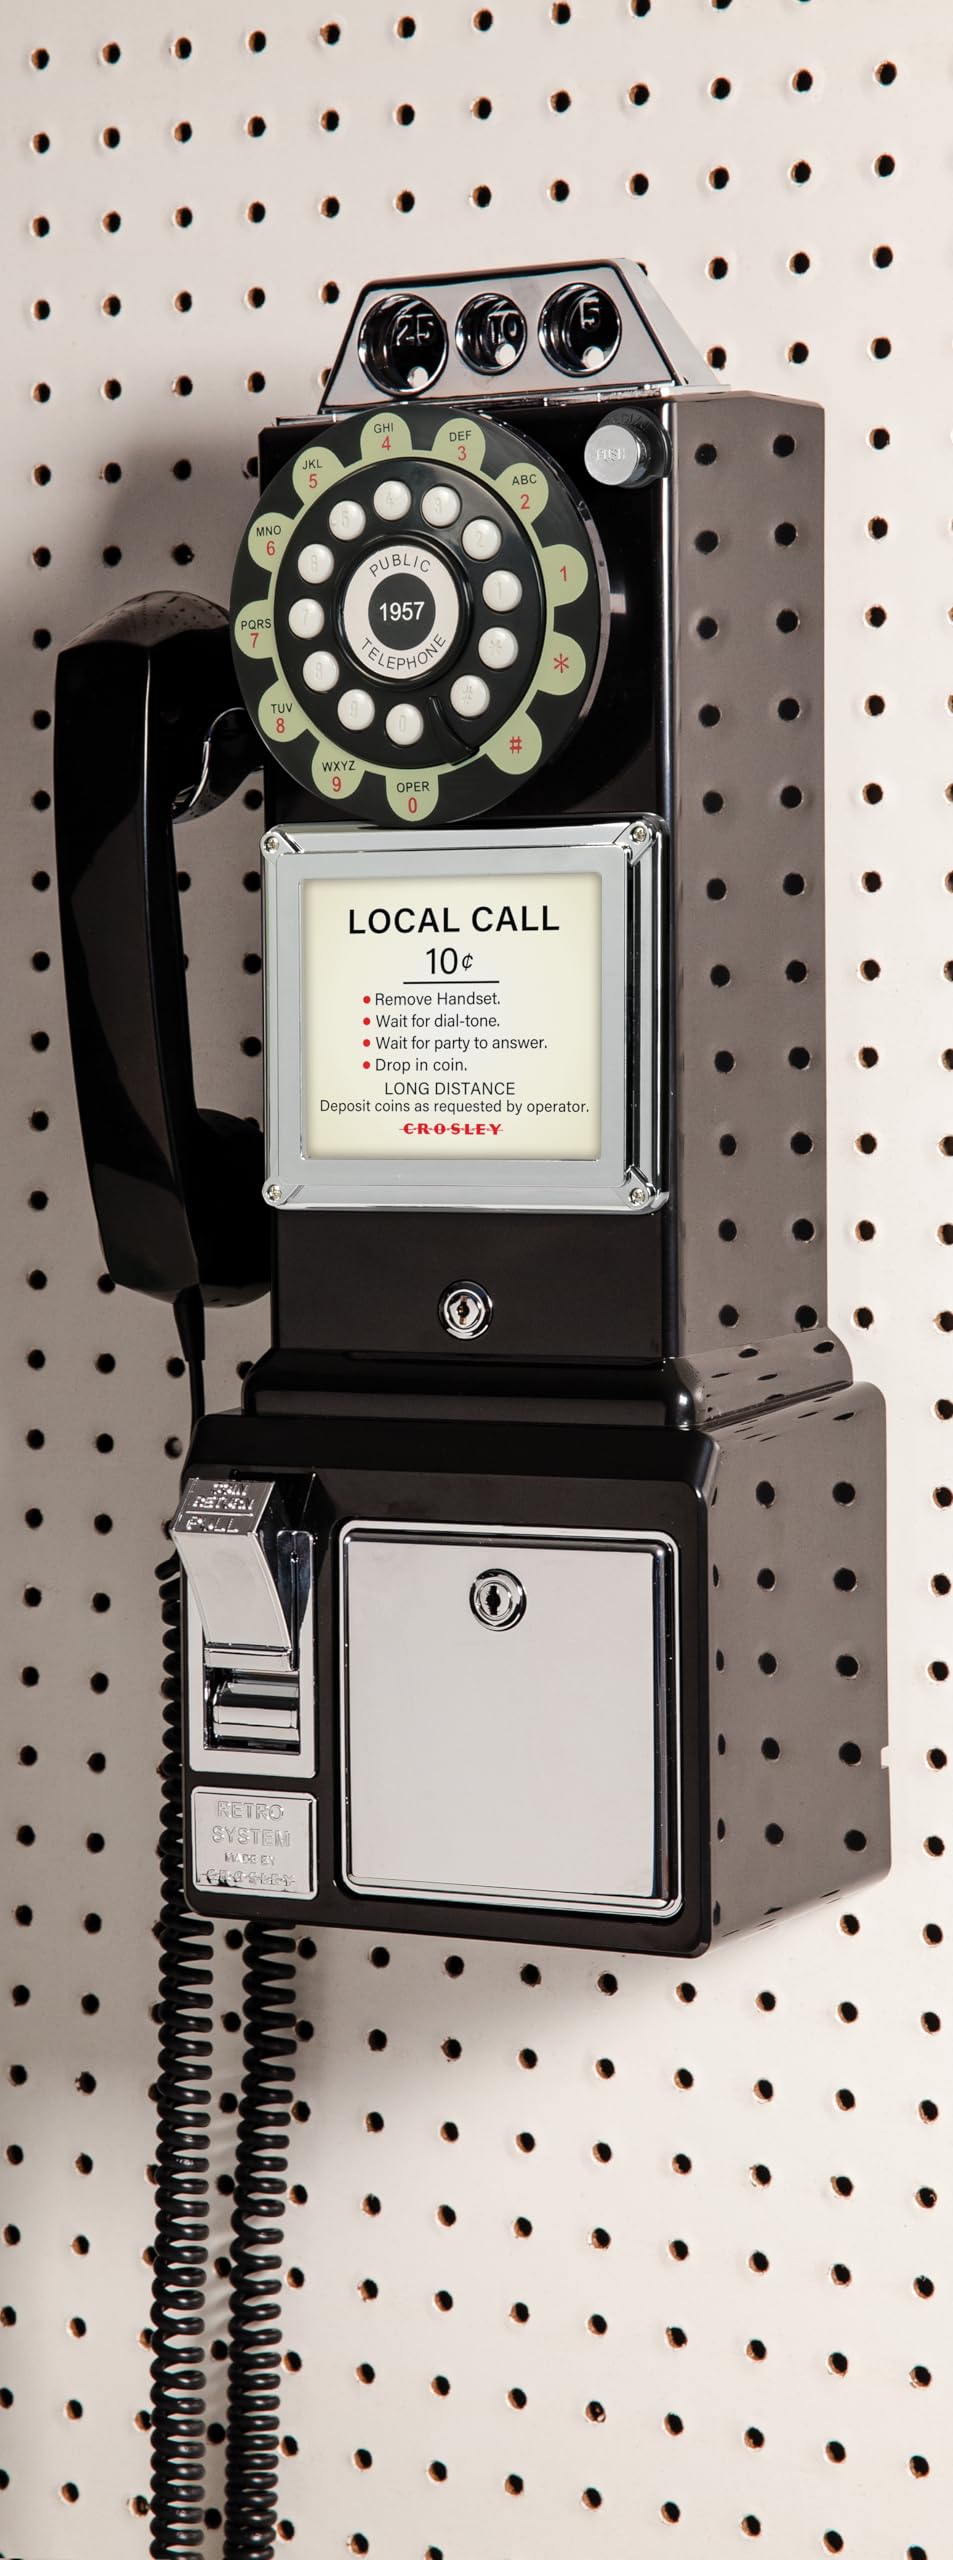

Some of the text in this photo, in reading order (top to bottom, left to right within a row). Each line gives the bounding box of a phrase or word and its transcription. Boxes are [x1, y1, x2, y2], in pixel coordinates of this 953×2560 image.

[579, 297, 600, 331] 5
[397, 312, 435, 346] 25
[374, 423, 393, 433] GHI
[381, 436, 391, 451] 4
[450, 431, 471, 442] DEF
[457, 445, 467, 461] 3
[303, 459, 322, 470] JKL
[308, 473, 318, 489] 5
[512, 474, 536, 485] ABC
[520, 493, 530, 510] 2
[256, 525, 282, 536] MNO
[266, 540, 276, 556] 6
[369, 553, 431, 578] PUBLIC
[559, 565, 568, 582] 1
[380, 601, 424, 621] 1957
[241, 618, 272, 630] PQRS
[250, 632, 259, 648] 7
[360, 633, 446, 671] TELEPHONE
[271, 703, 292, 713] TUV
[276, 717, 285, 734] 8
[510, 736, 523, 754] #
[322, 760, 355, 772] WXYZ
[332, 776, 342, 792] 9
[397, 781, 430, 793] OPER
[408, 797, 417, 814] 0
[349, 905, 560, 934] LOCAL CALL
[426, 947, 473, 975] 10¢
[376, 992, 500, 1006] Remove Handset.
[376, 1014, 499, 1027] Wait for dial-tone.
[376, 1036, 547, 1052] Wait for party to answer.
[376, 1057, 467, 1074] Drop in coin.
[385, 1082, 515, 1095] LONG DISTANCE
[321, 1099, 589, 1115] Deposit coins as requested by operator.
[402, 1123, 501, 1135] CROSLEY
[217, 1800, 284, 1820] RETRO
[212, 1825, 291, 1847] SYSTEM
